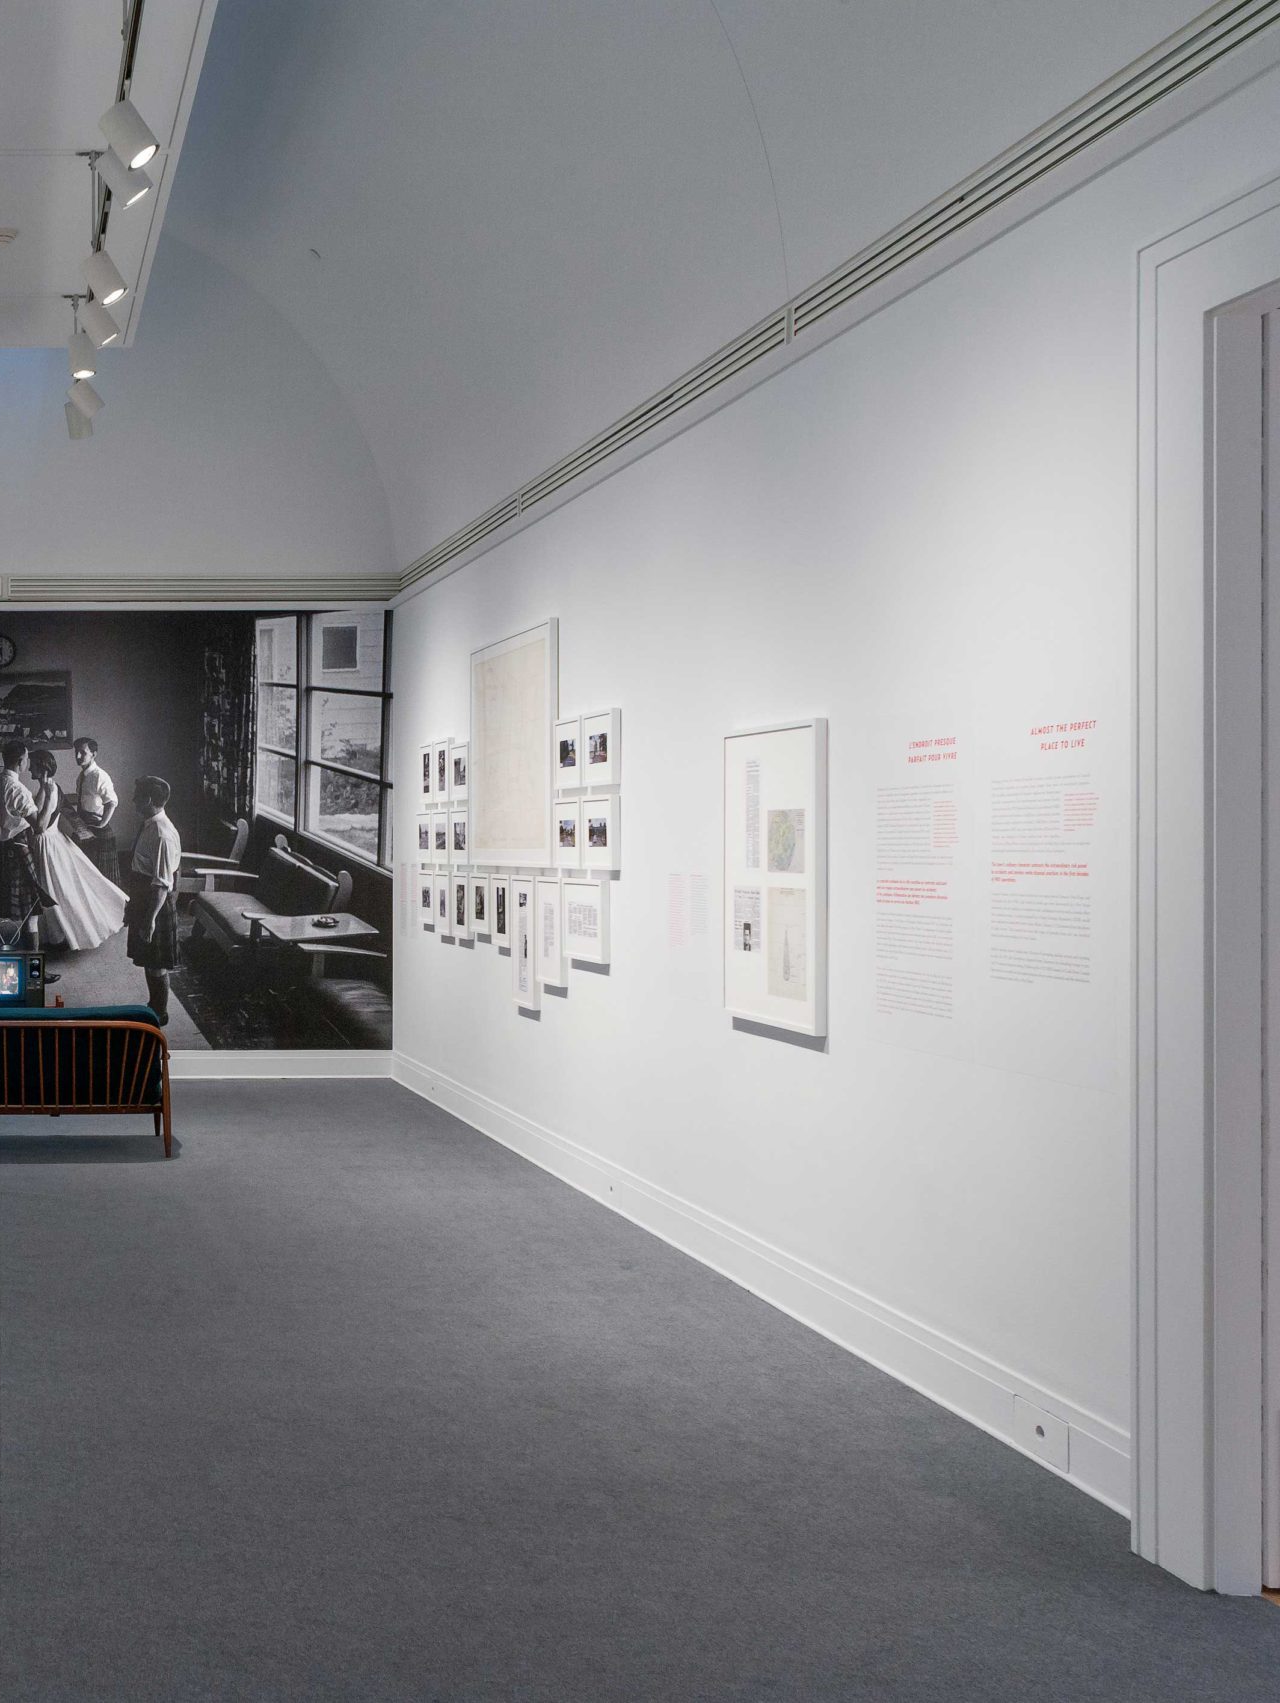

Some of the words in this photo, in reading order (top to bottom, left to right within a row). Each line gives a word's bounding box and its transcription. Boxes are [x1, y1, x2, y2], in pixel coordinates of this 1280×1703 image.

[1030, 725, 1054, 736] ALMOST
[1056, 723, 1068, 733] THE
[1069, 720, 1097, 732] PERFECT
[1040, 741, 1059, 751] PLACE
[1060, 740, 1069, 750] TO
[1070, 738, 1086, 749] LIVE
